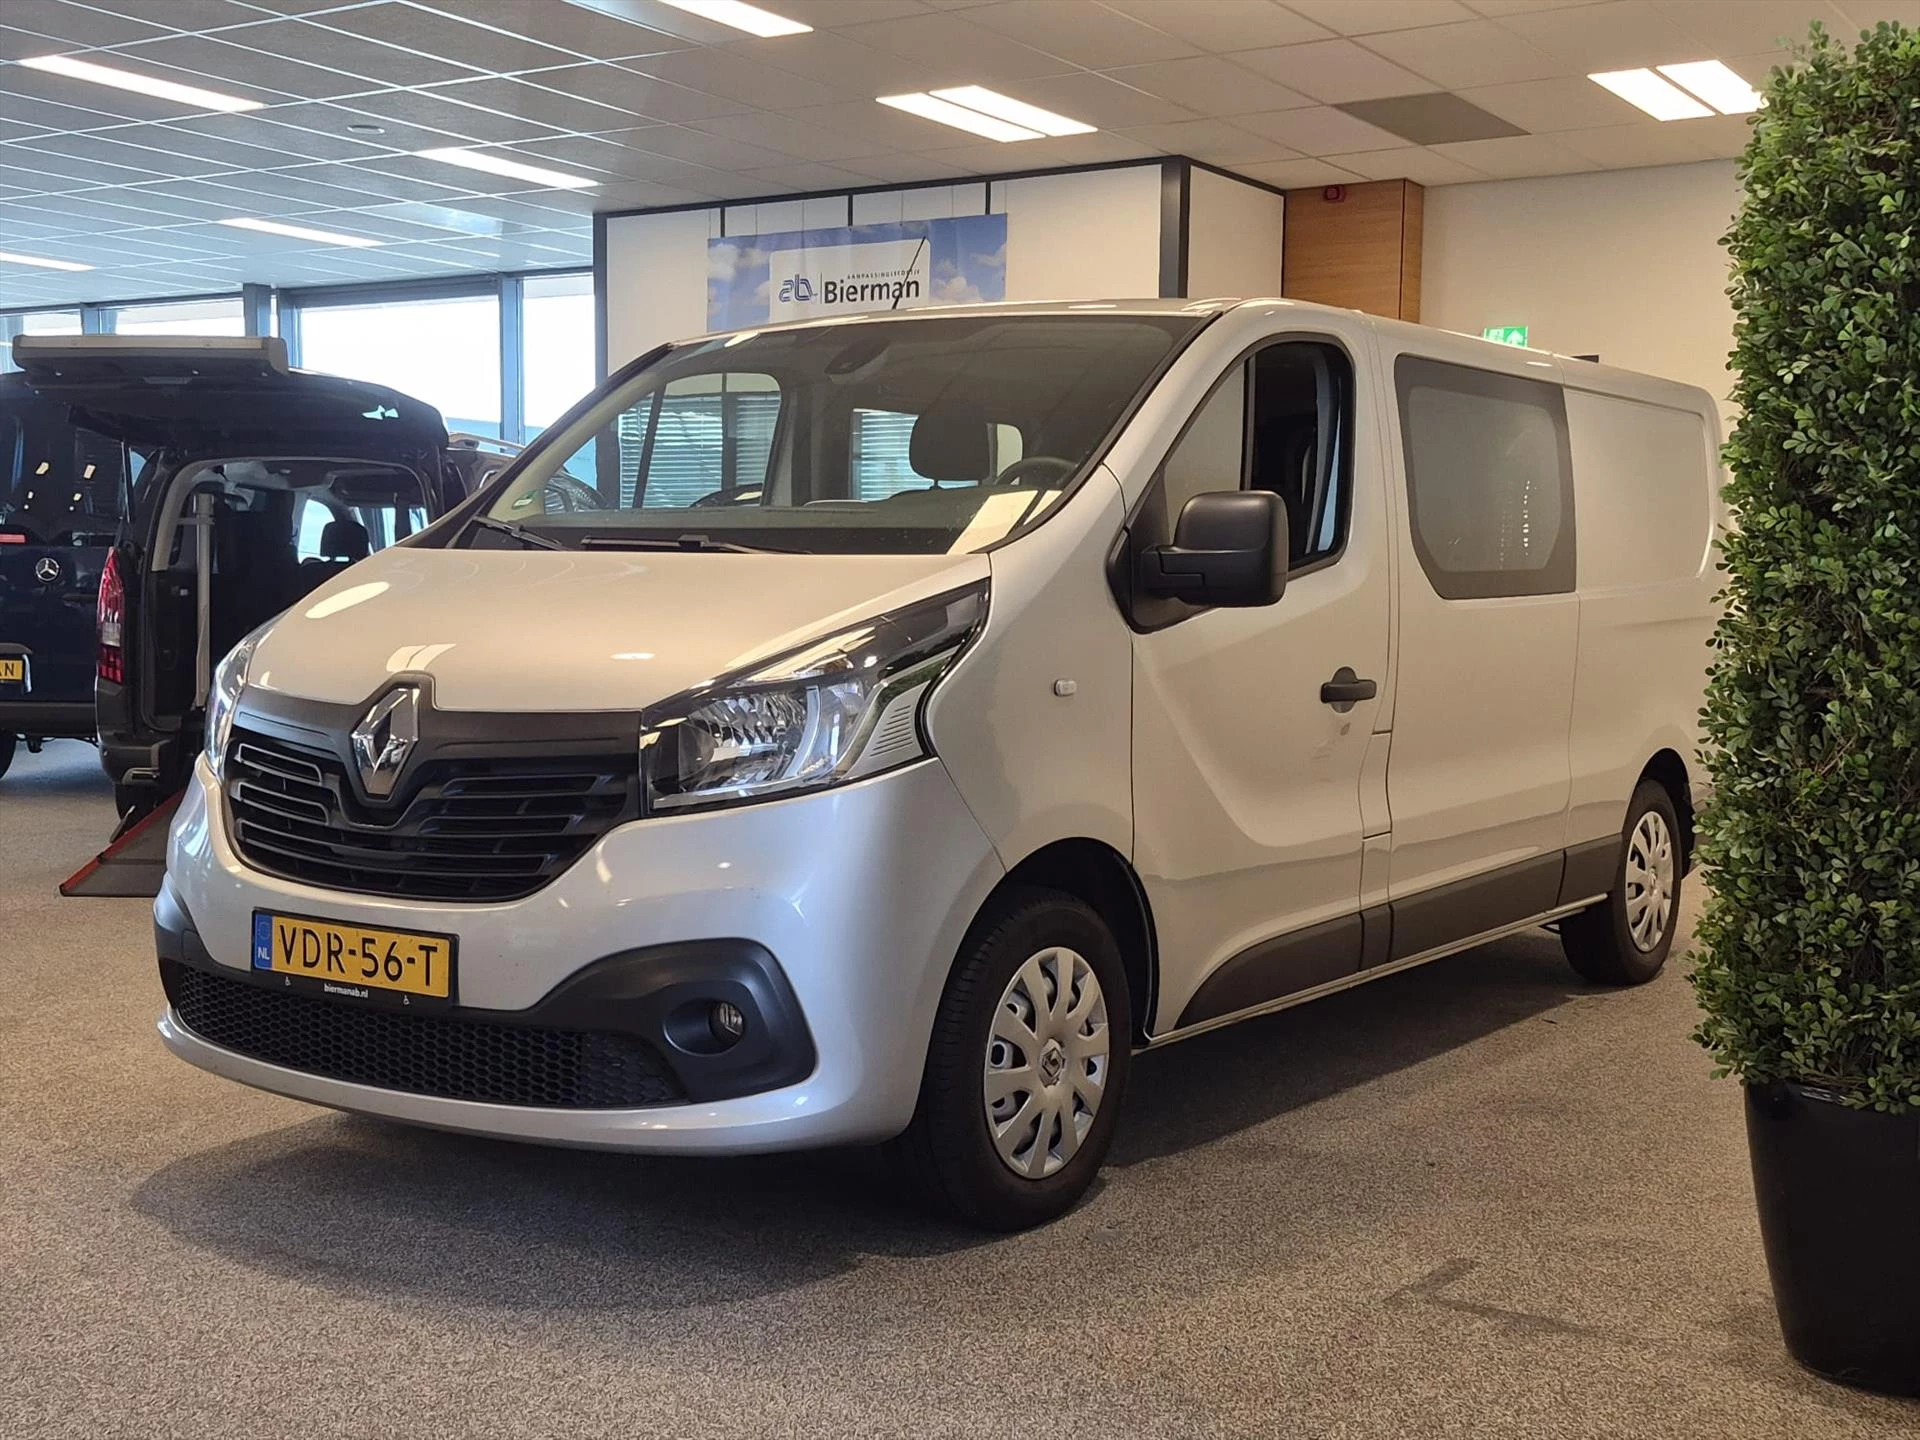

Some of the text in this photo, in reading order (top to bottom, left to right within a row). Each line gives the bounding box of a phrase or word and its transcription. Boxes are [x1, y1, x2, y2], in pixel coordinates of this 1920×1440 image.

[825, 280, 920, 303] Bierman
[0, 662, 14, 677] N
[258, 947, 270, 961] NL
[279, 925, 438, 987] VDR-56-T
[324, 983, 368, 998] biermanab.nl
